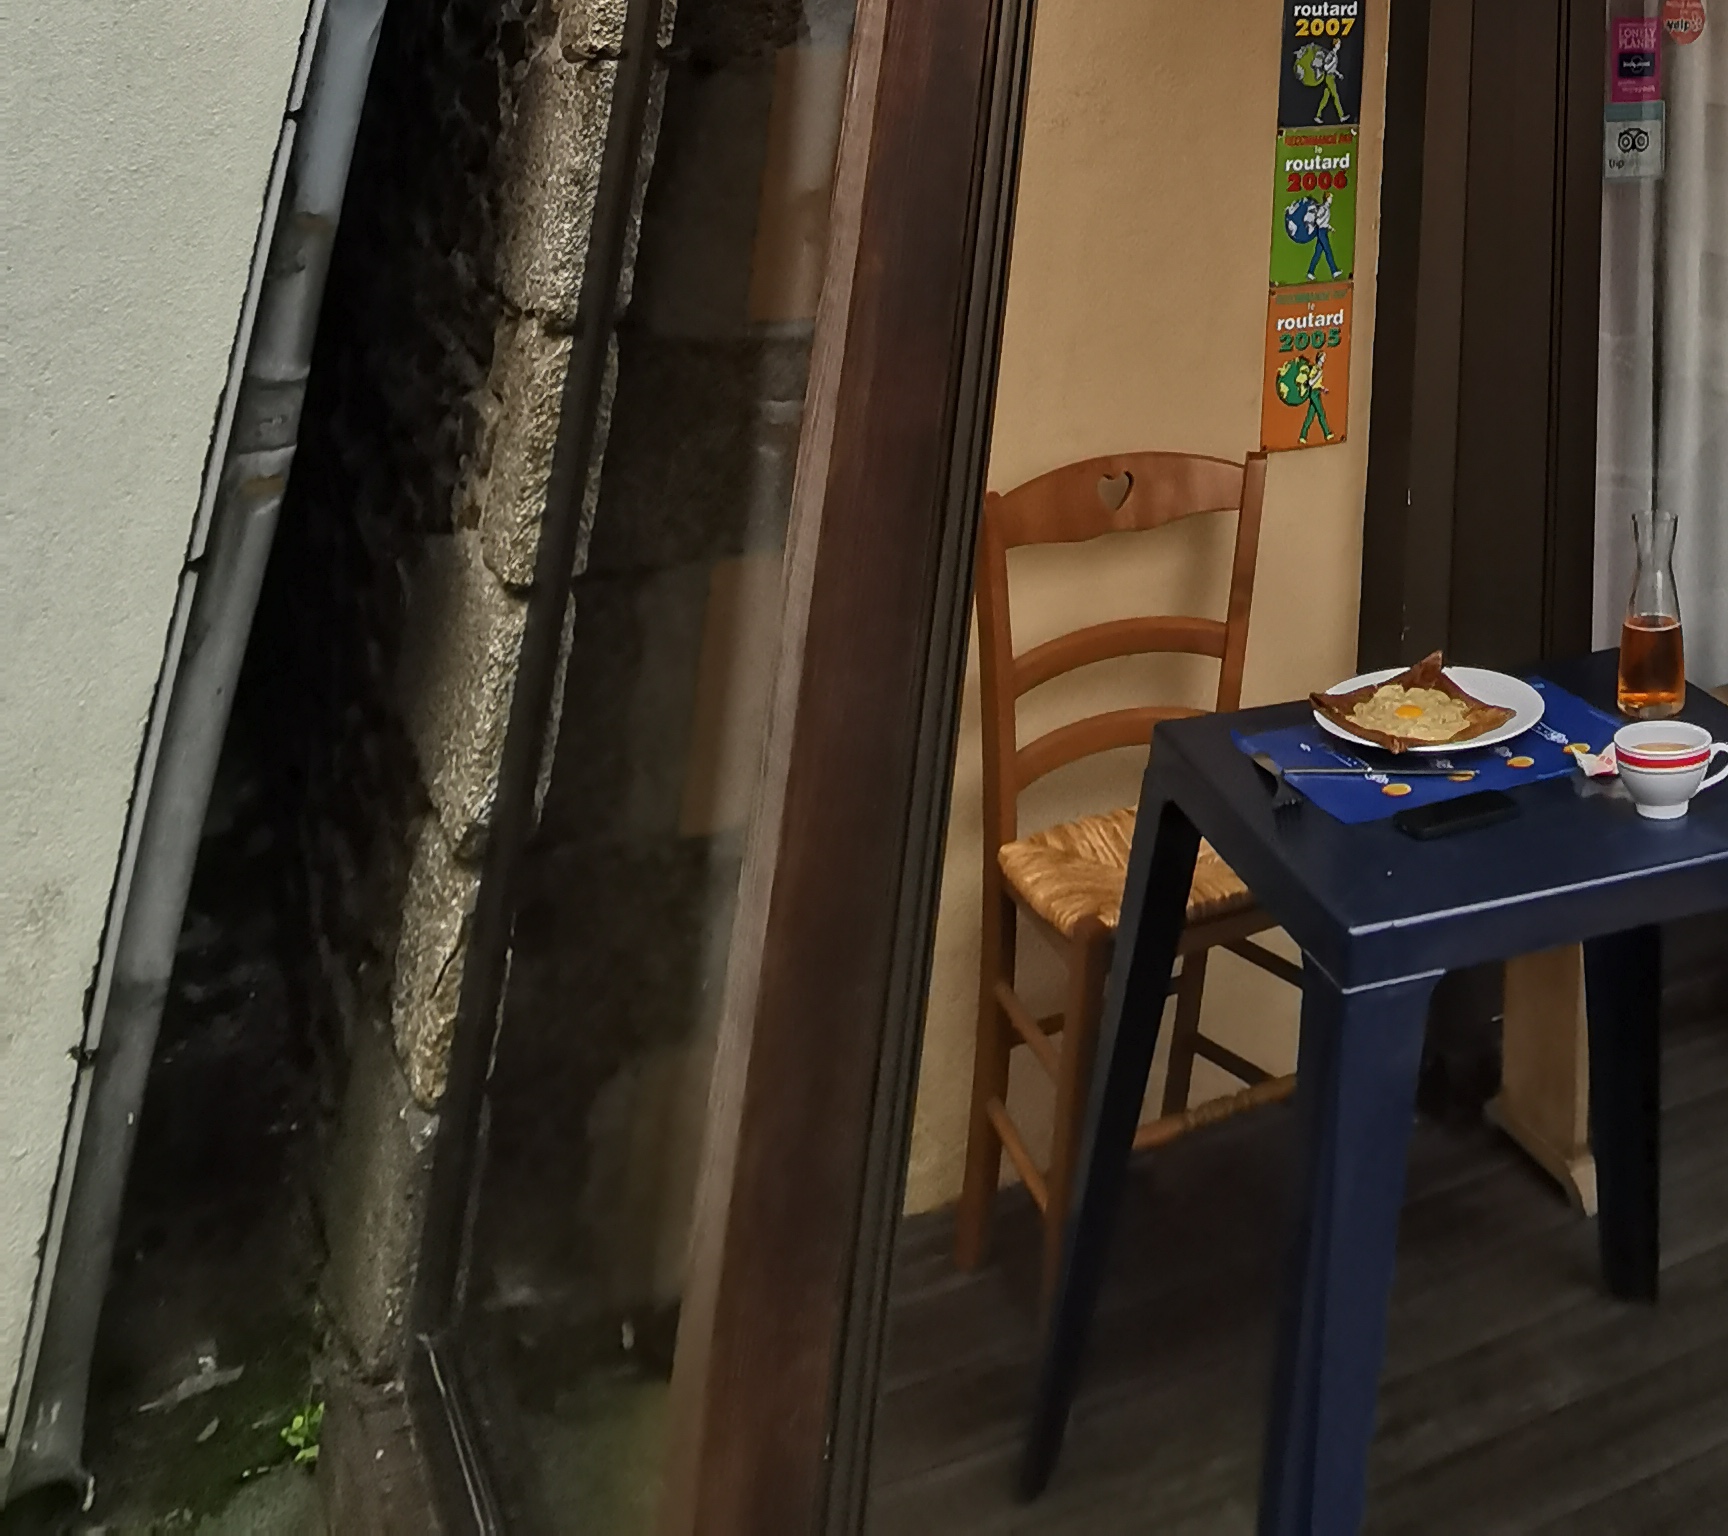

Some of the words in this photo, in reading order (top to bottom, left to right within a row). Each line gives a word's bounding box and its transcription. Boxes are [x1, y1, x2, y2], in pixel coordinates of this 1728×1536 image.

[1294, 0, 1358, 16] routard
[1295, 18, 1356, 37] 2007
[1285, 153, 1350, 172] routard
[1286, 170, 1348, 193] 2006
[1276, 309, 1344, 331] routard
[1279, 328, 1341, 353] 2005
